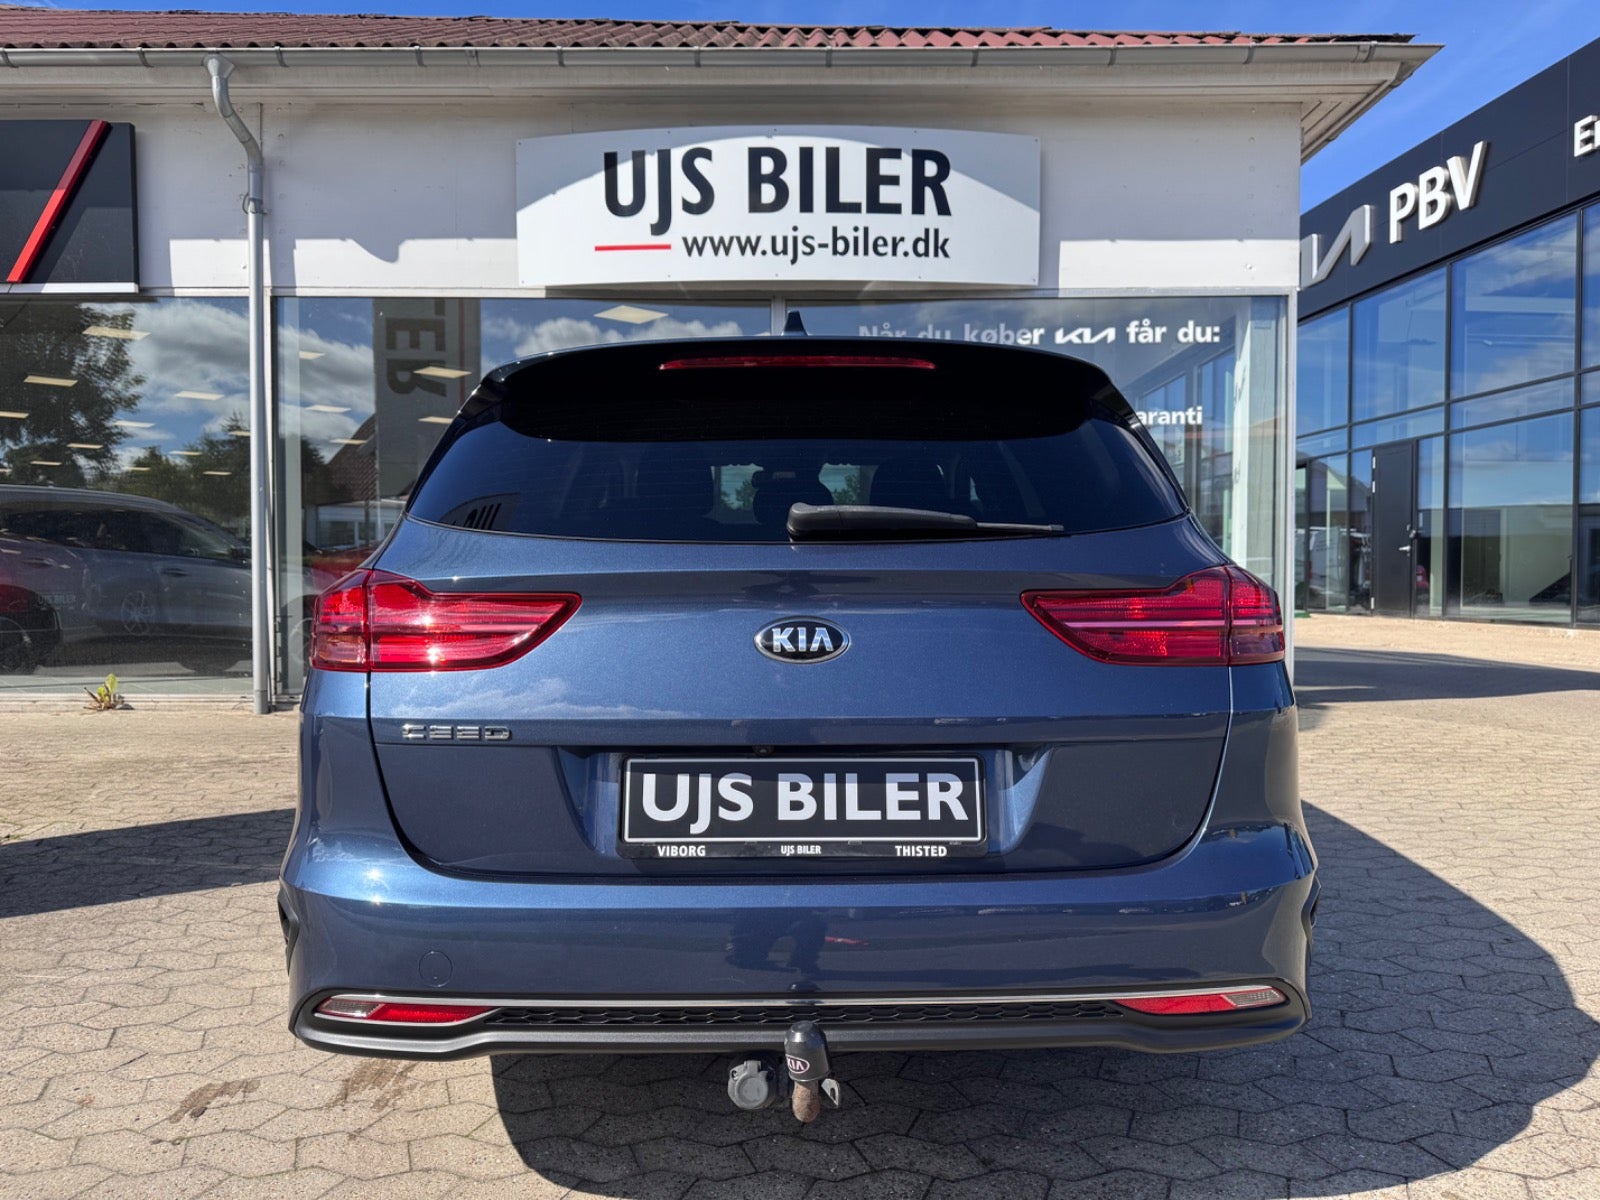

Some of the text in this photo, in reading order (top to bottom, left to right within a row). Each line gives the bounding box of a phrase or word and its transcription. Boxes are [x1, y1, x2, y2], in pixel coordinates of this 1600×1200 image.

[1574, 115, 1600, 157] E
[603, 147, 952, 236] UJS BILER
[1390, 141, 1488, 244] PBV
[682, 226, 951, 265] www.ujs-biler.dk
[964, 323, 1045, 345] køber
[1126, 318, 1166, 343] får
[1177, 320, 1221, 343] du:
[1138, 406, 1203, 424] aranti
[771, 627, 834, 652] KIA
[642, 773, 968, 834] UJS BILER
[657, 845, 706, 857] VIBORG
[781, 844, 822, 855] UJS BILER
[895, 845, 947, 857] THISTED
